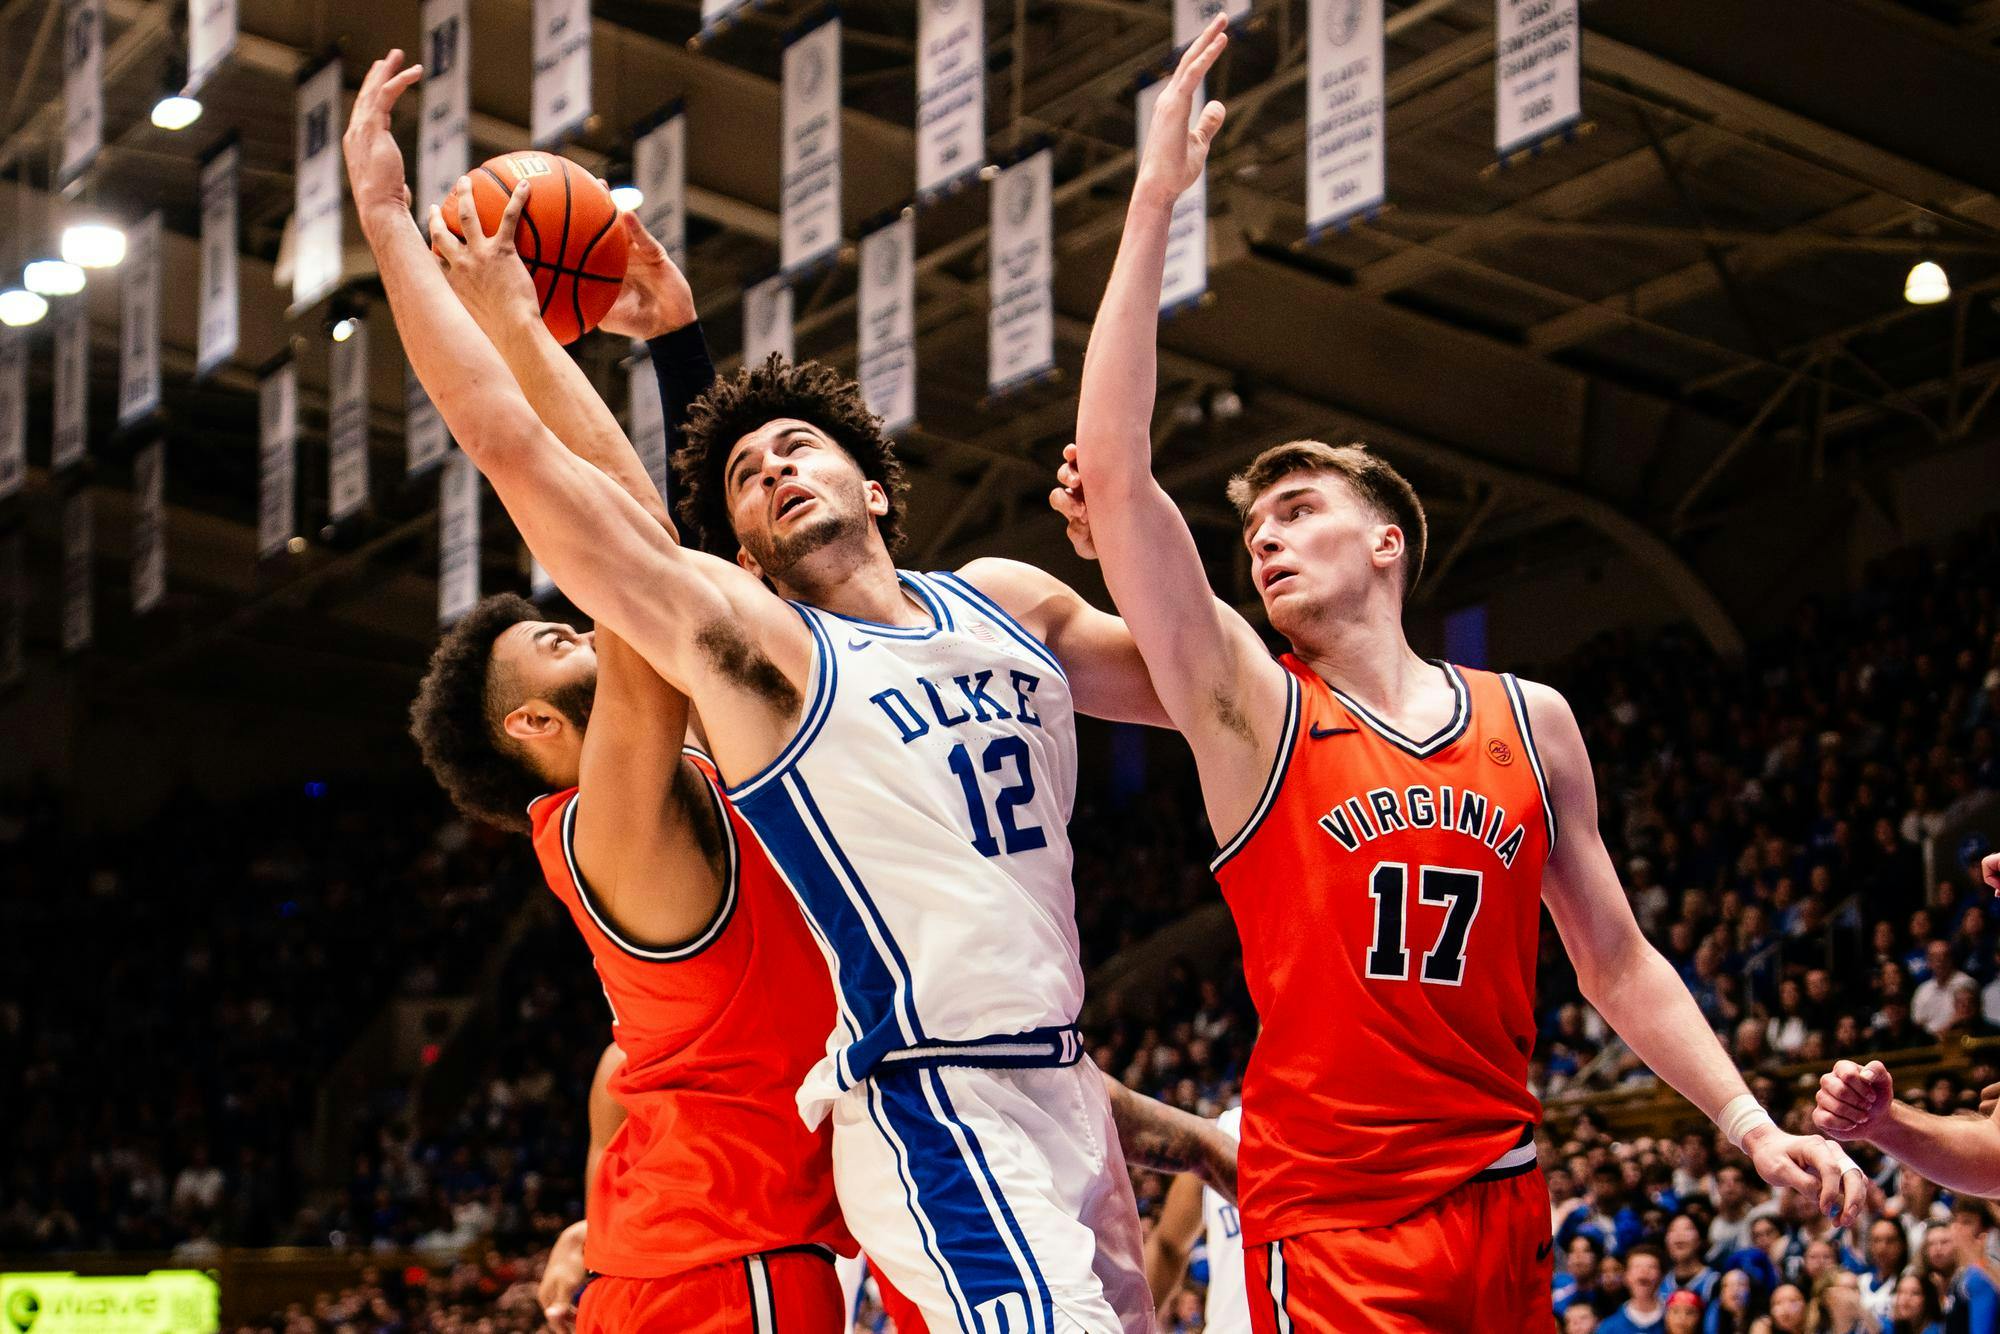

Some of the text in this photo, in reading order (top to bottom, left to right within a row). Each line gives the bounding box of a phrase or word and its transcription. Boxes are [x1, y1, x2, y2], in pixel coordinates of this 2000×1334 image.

[869, 669, 1043, 745] DUKE
[947, 735, 1048, 858] 12
[1318, 785, 1525, 869] VIRGINIA
[1365, 861, 1483, 986] 17
